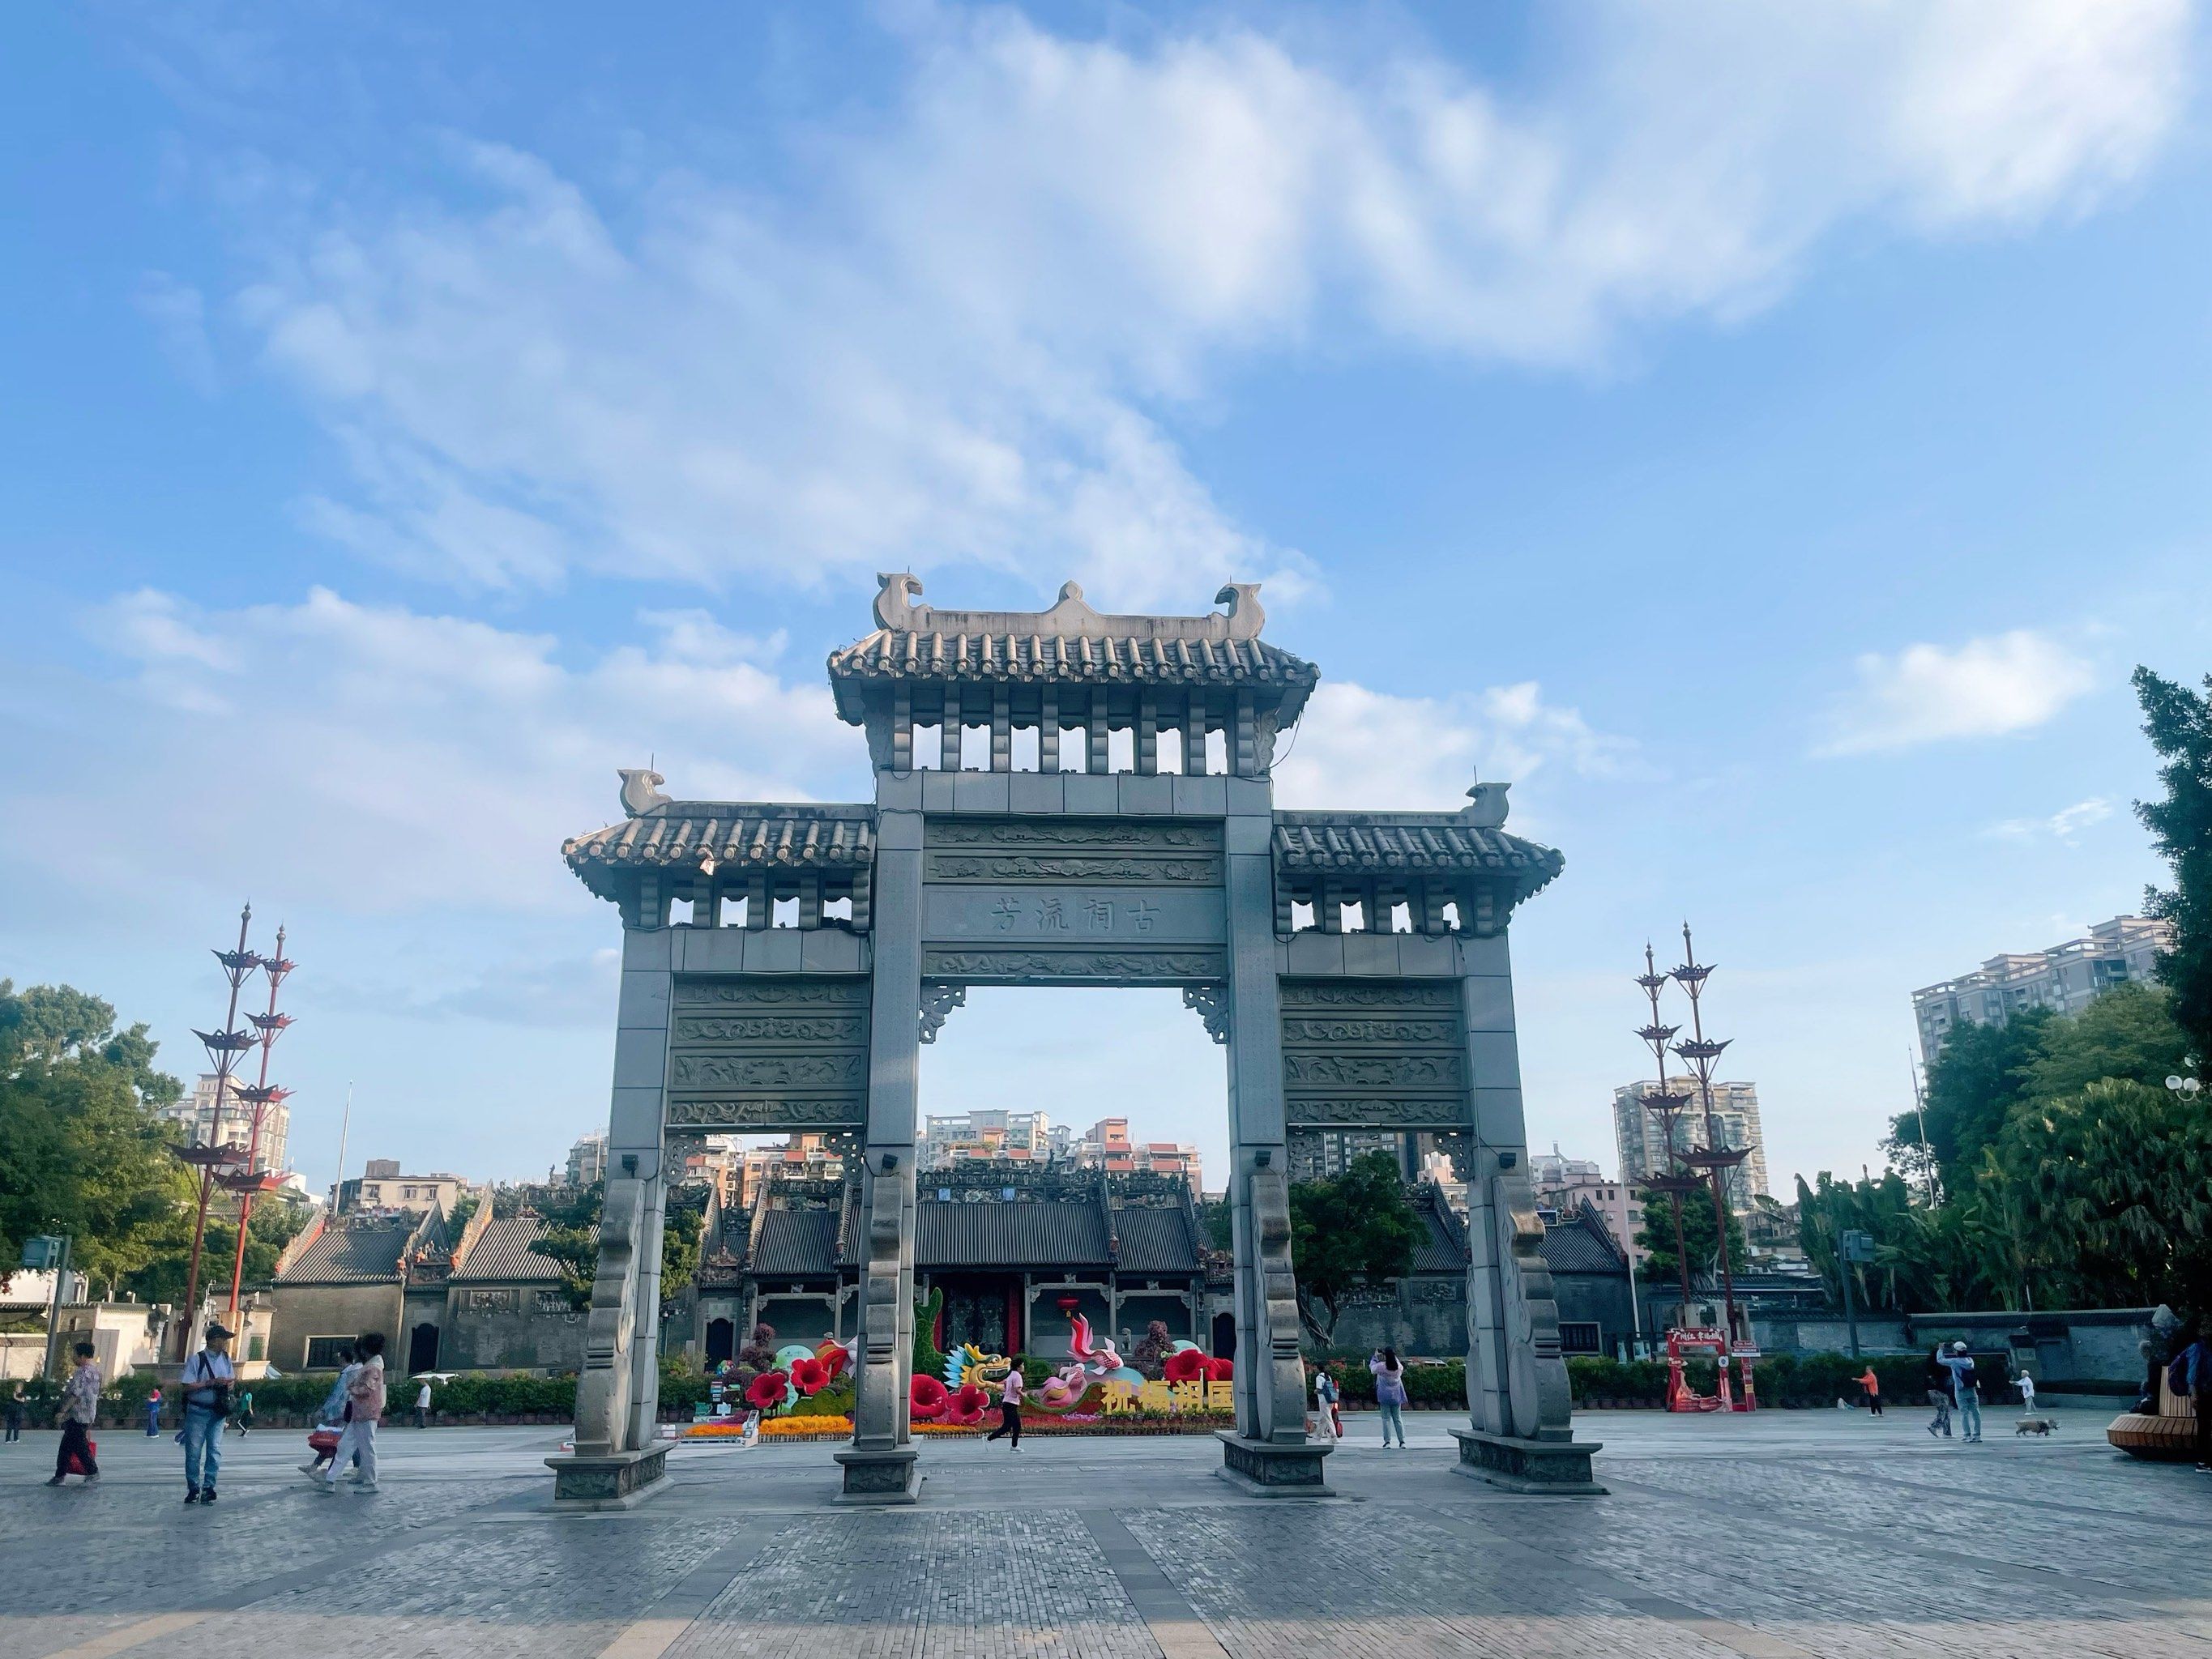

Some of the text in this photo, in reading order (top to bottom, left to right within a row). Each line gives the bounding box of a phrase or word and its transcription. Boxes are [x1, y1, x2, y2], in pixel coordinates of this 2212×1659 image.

[990, 898, 1162, 932] 古祠流芳
[1101, 1380, 1233, 1415] 祝福祖国
